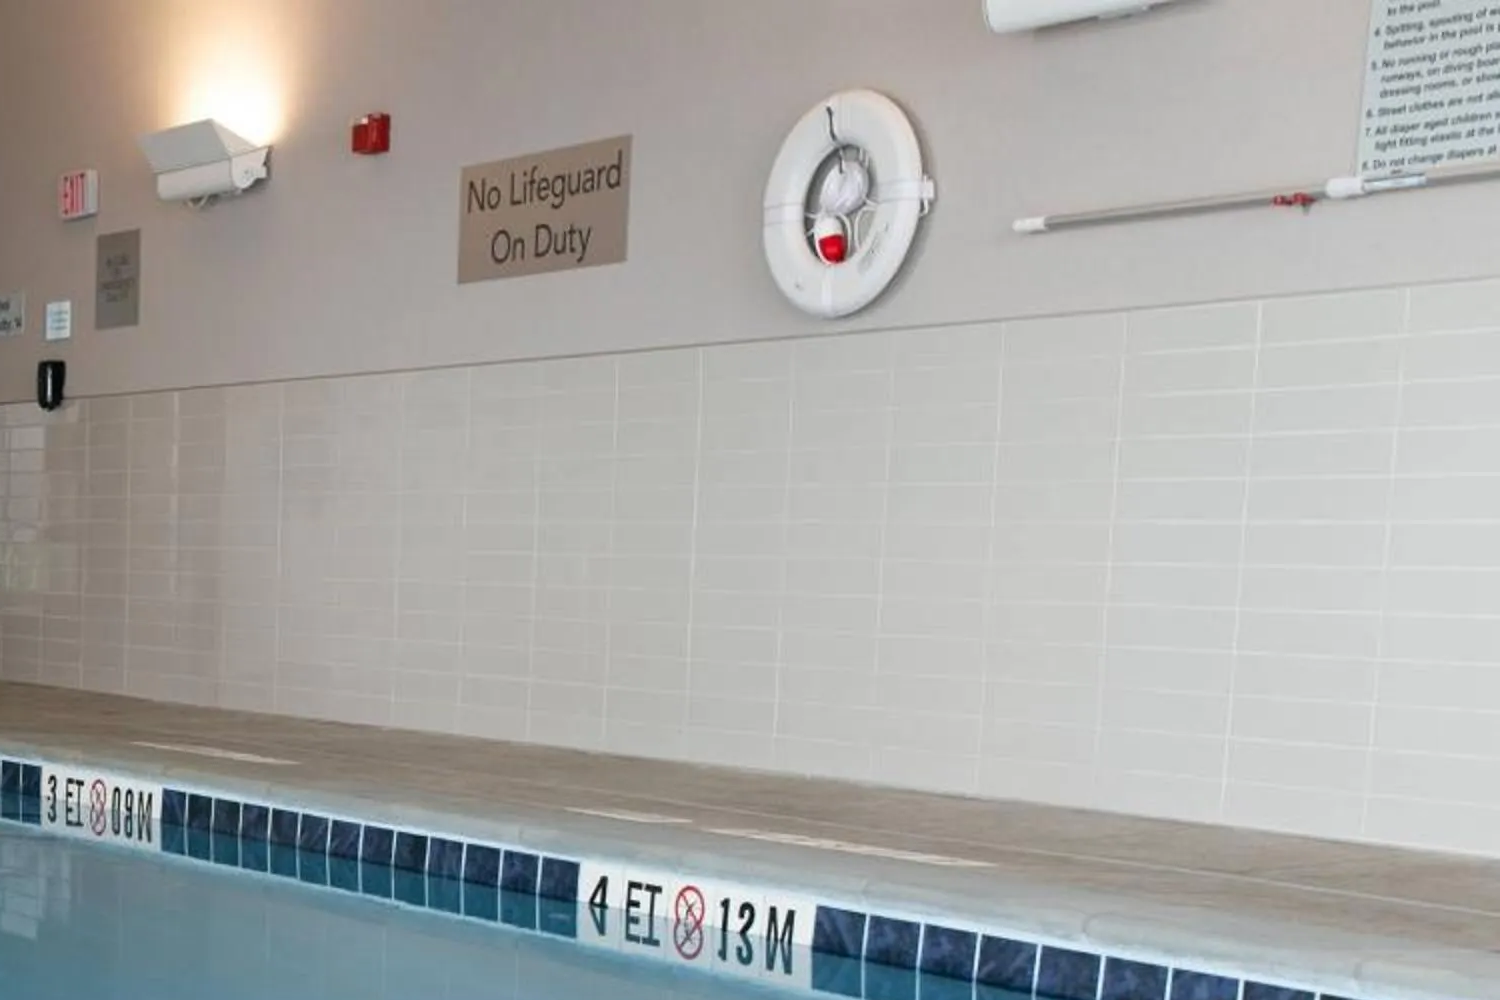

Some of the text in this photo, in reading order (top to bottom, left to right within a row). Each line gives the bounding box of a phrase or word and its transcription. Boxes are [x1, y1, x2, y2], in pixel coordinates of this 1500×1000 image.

[1441, 30, 1457, 41] the
[1451, 112, 1493, 126] children
[1373, 158, 1387, 170] Do
[1390, 156, 1405, 168] not
[1407, 153, 1445, 165] change
[467, 148, 624, 214] No Lifeguard
[490, 222, 592, 265] On Duty
